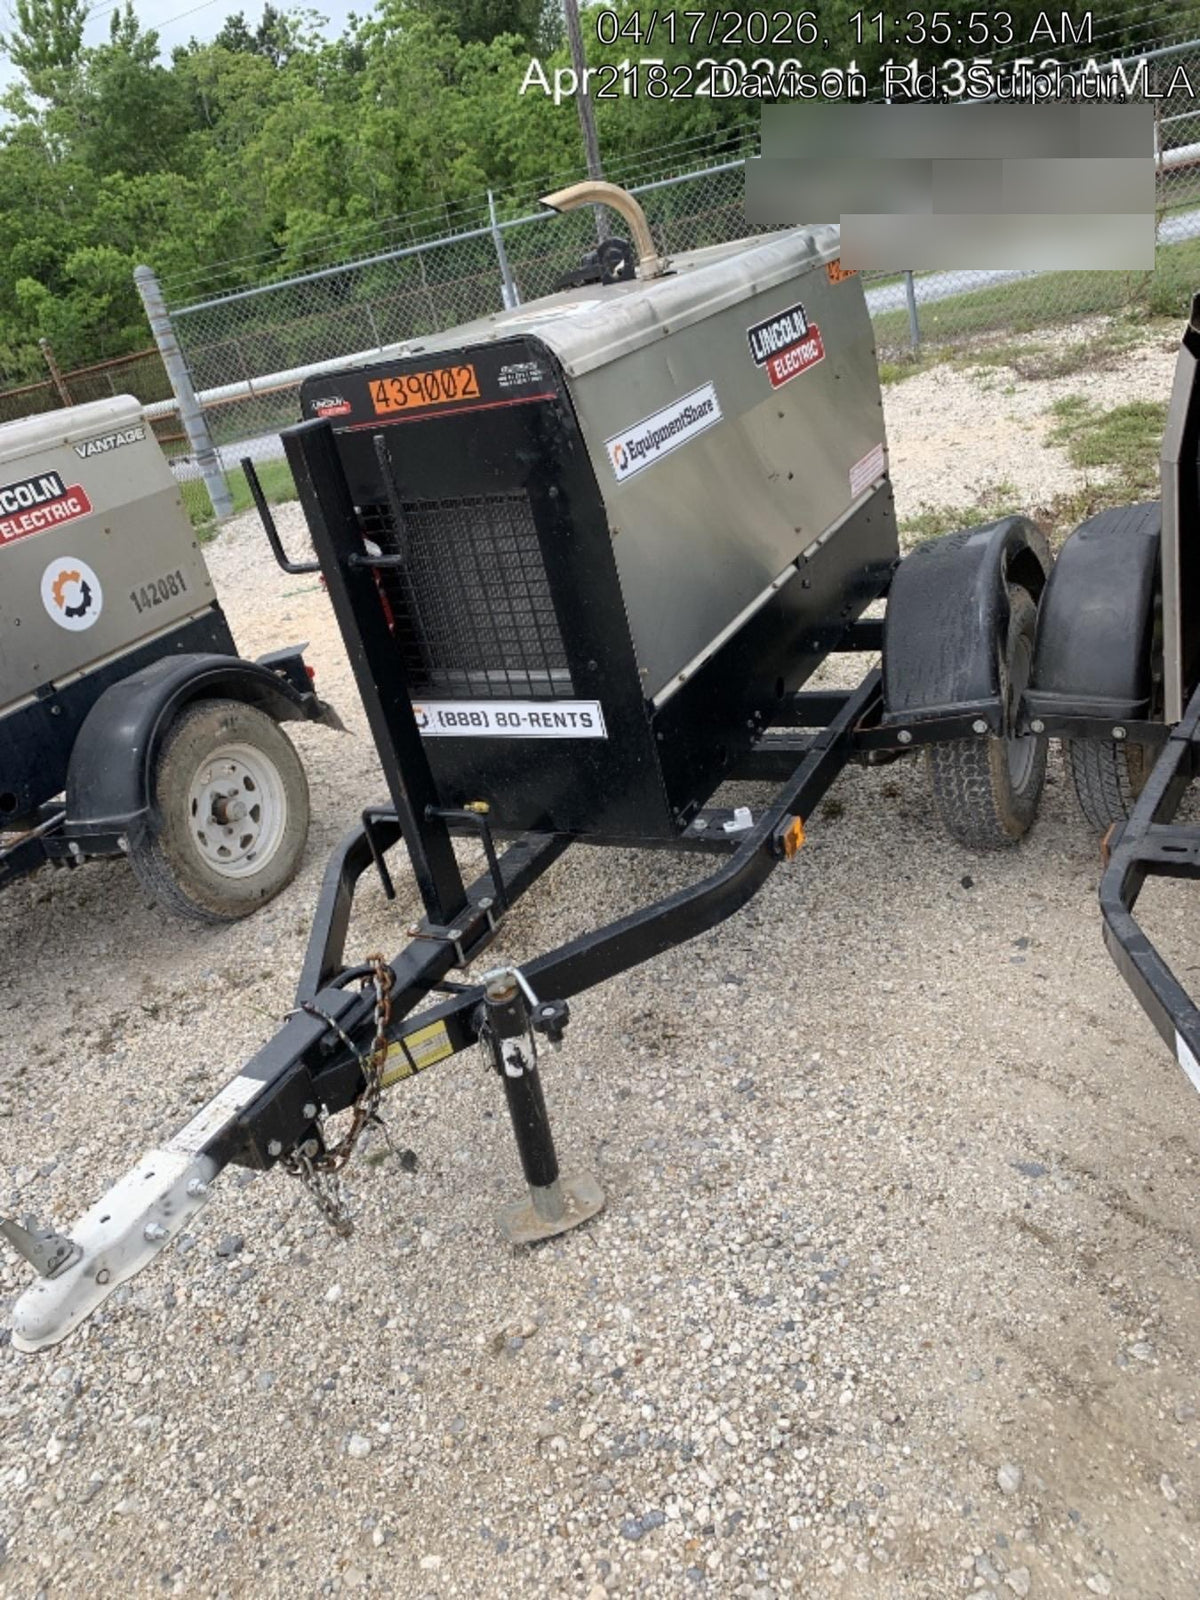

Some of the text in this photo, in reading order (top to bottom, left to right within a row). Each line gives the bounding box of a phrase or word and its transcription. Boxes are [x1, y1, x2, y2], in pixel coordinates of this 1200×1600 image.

[750, 310, 808, 360] LINCOLN
[773, 338, 820, 380] ELECTRIC
[374, 365, 478, 409] 439002
[75, 428, 145, 459] VANTAGE
[626, 398, 714, 460] EquipmentShare
[0, 497, 82, 539] ELECTRIC
[130, 569, 187, 614] 142081
[437, 710, 593, 728] (888) 80-RENTS
